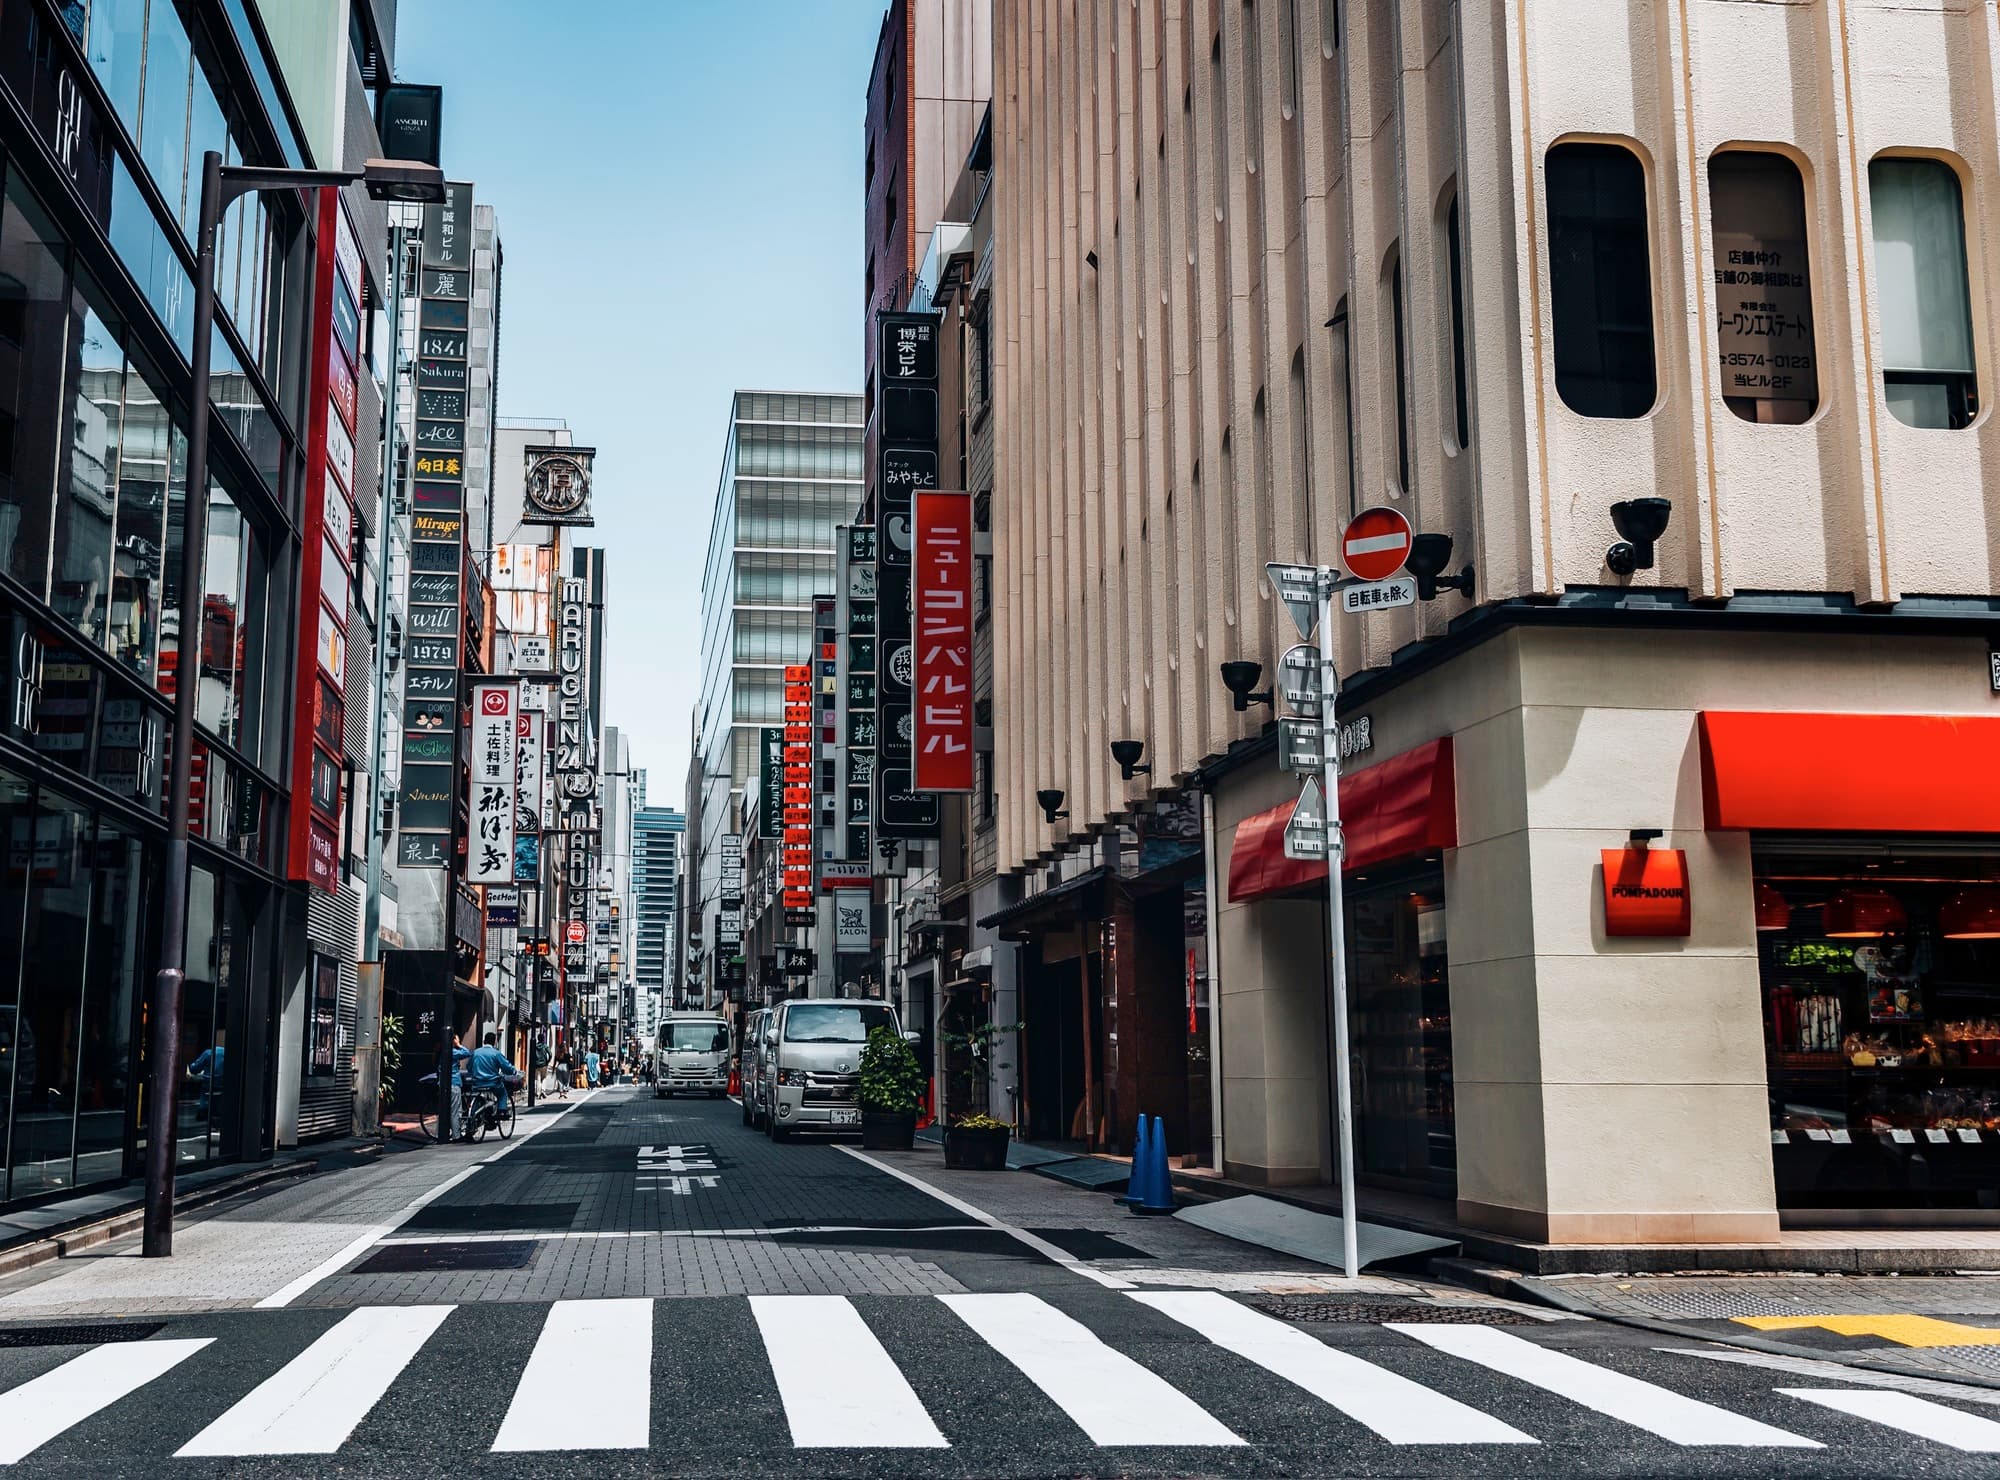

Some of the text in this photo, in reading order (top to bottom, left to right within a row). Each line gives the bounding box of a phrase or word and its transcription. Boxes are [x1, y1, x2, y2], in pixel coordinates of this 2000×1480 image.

[1728, 249, 1782, 266] 店舗仲介
[433, 272, 457, 295] 麗
[422, 338, 465, 356] 1841
[897, 327, 918, 377] 博栄ビル
[420, 365, 465, 378] Sakura
[422, 394, 460, 415] VR
[886, 470, 935, 485] みやもと
[414, 516, 461, 533] Mirage
[1348, 585, 1409, 608] 自転車を除く
[411, 607, 456, 628] will
[413, 645, 452, 659] 1979
[407, 677, 454, 691] エテルノ
[486, 723, 501, 777] 土佐料理
[404, 843, 444, 861] 最上
[1611, 887, 1685, 899] POMPADOUR
